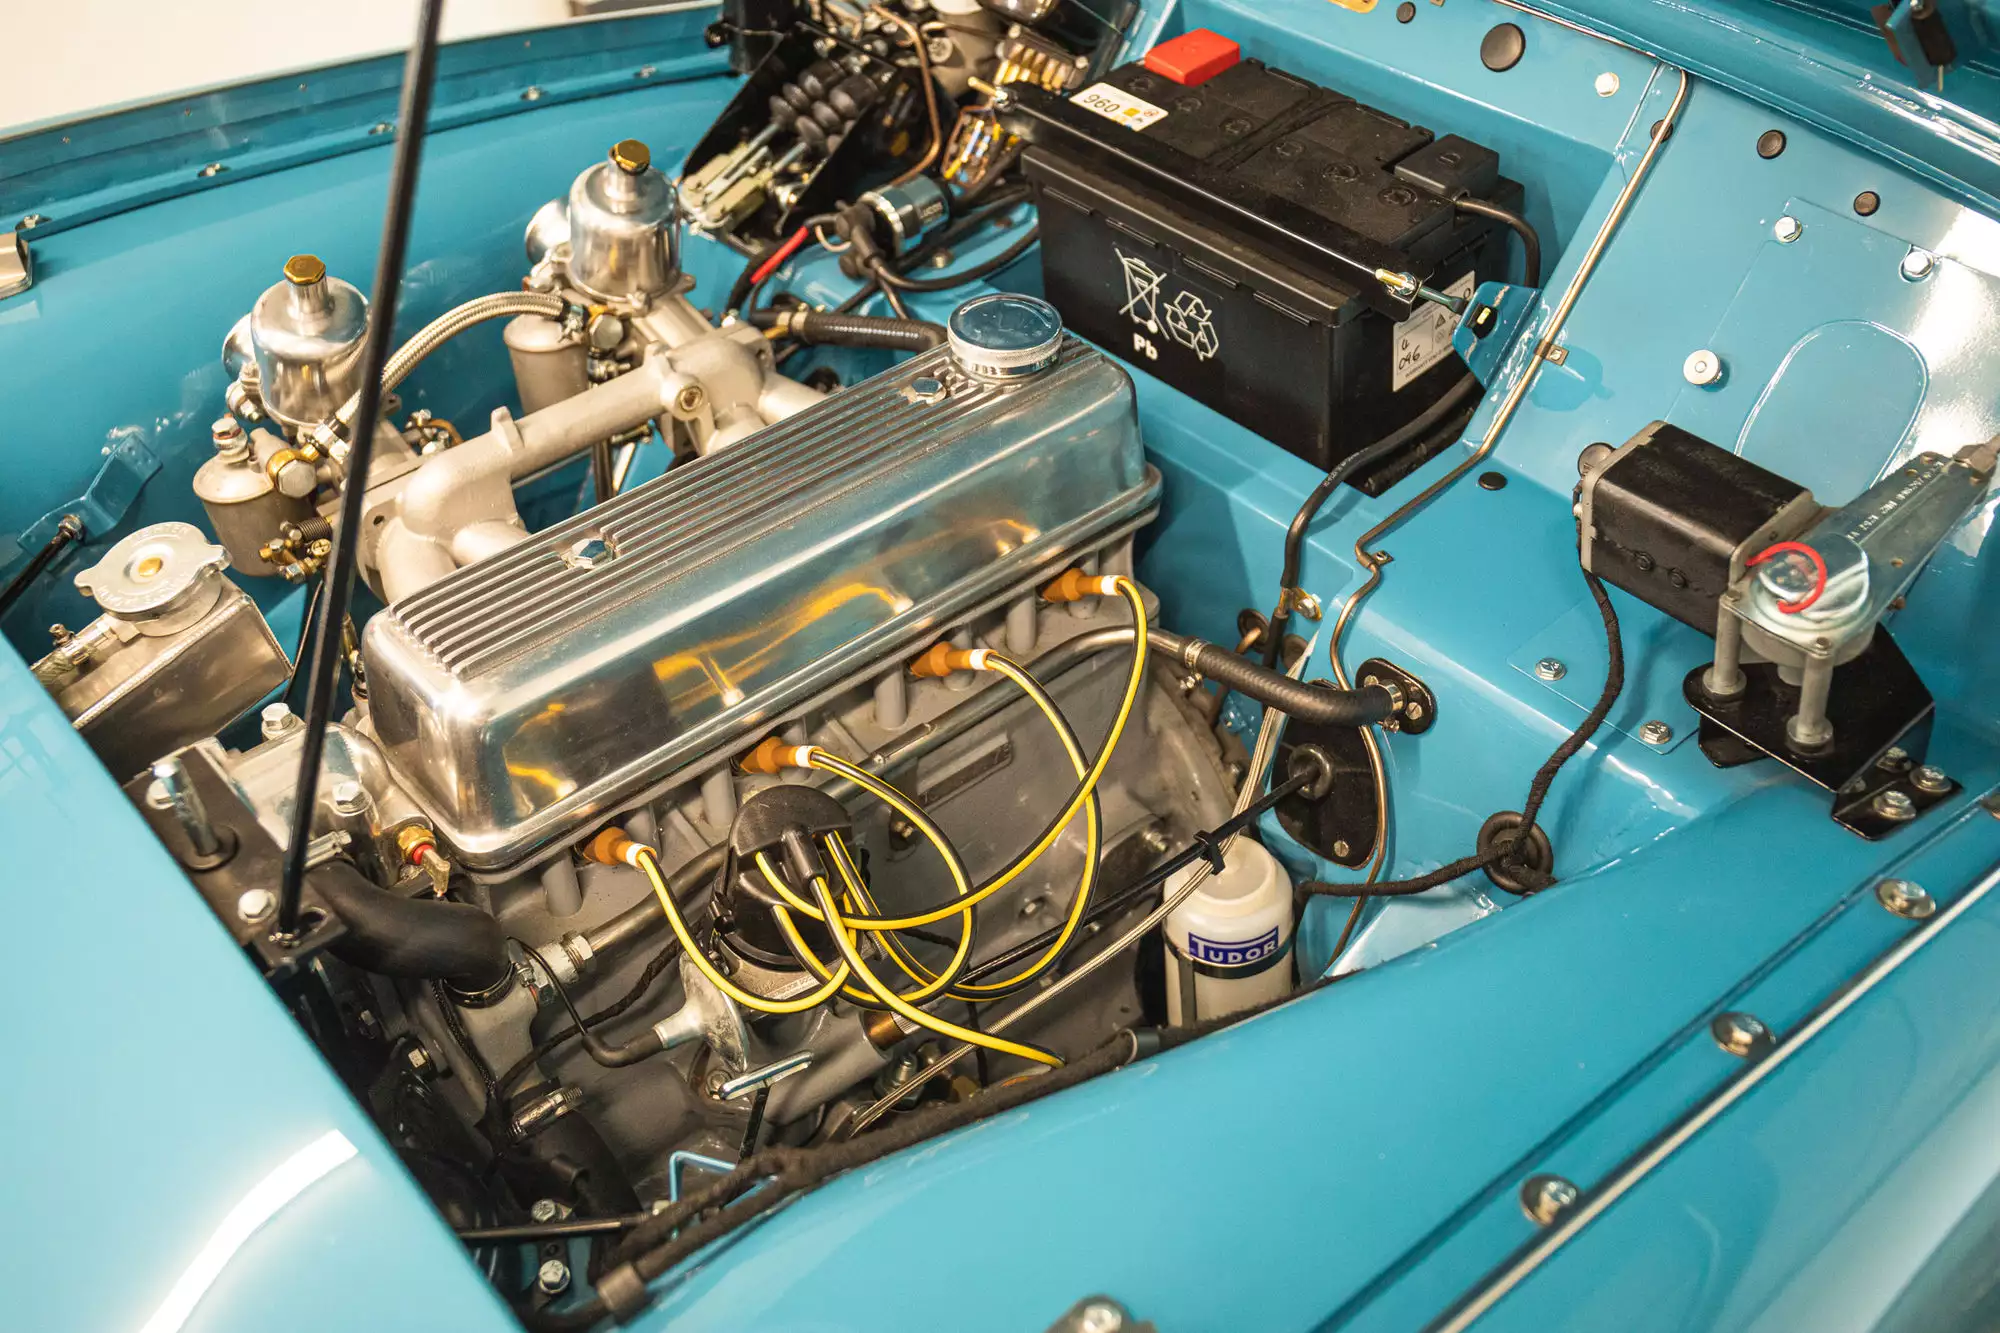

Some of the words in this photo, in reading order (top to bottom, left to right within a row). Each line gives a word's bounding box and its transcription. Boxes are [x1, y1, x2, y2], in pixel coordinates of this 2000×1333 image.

[1133, 333, 1158, 360] Pb
[1399, 344, 1420, 370] 096
[1191, 929, 1277, 963] TUDOR
